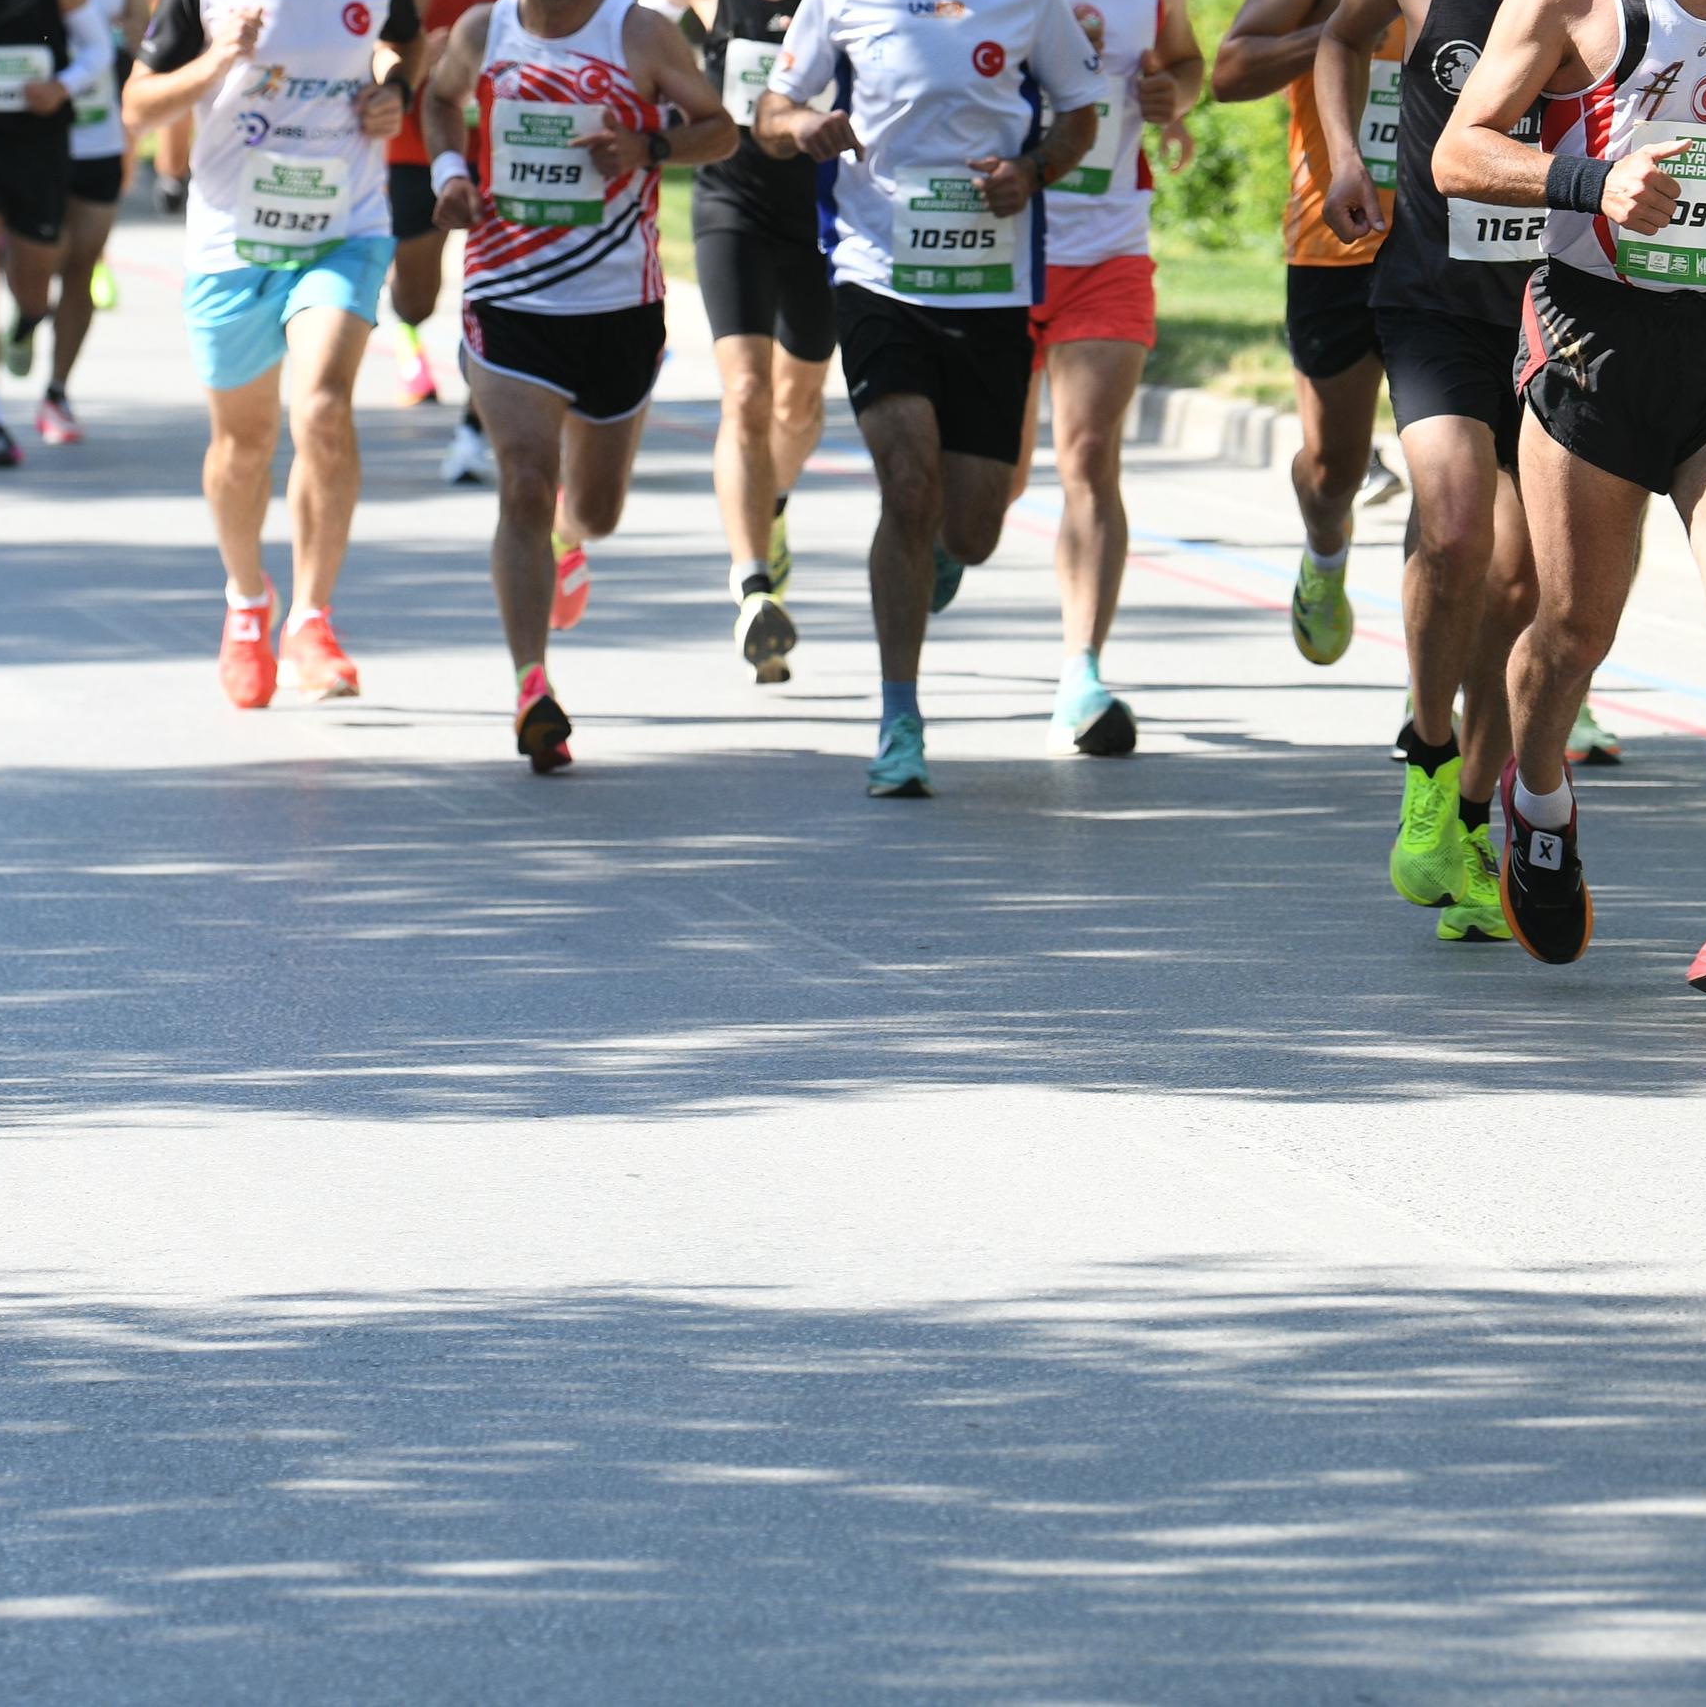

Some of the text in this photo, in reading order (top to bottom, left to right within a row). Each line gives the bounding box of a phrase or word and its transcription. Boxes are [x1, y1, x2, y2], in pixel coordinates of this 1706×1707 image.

[1369, 121, 1398, 143] 10
[510, 161, 582, 185] 11459
[254, 207, 331, 232] 10327
[1476, 216, 1547, 242] 1162
[910, 229, 996, 250] 10505
